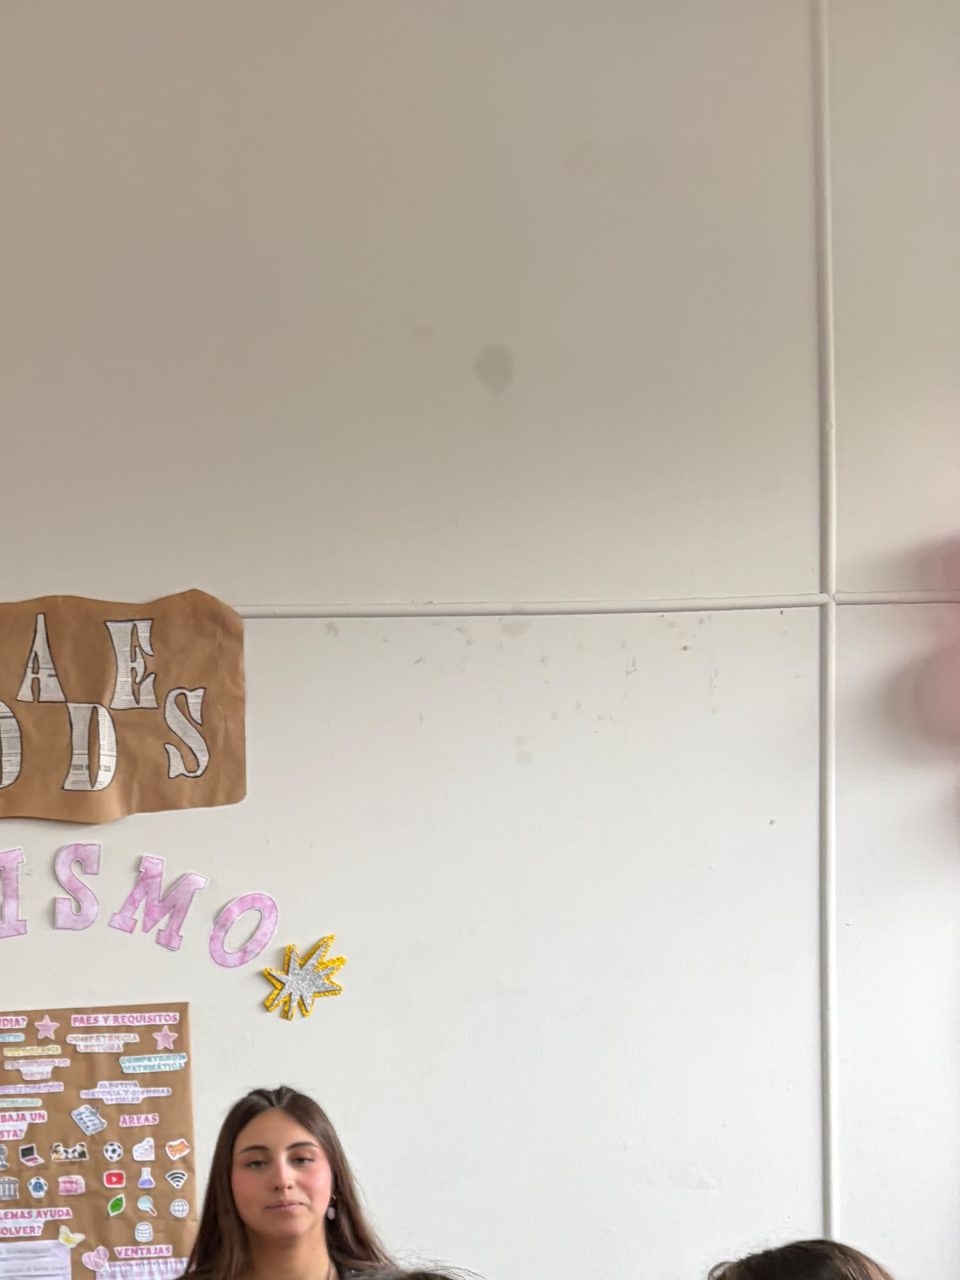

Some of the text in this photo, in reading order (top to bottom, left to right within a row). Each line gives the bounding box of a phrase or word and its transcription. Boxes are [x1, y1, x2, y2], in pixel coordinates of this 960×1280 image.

[73, 1013, 178, 1025] PAES Y REQUISITOS
[30, 1112, 46, 1121] UN
[35, 1208, 72, 1219] AYUDA
[116, 1246, 172, 1258] VENTAJAS
